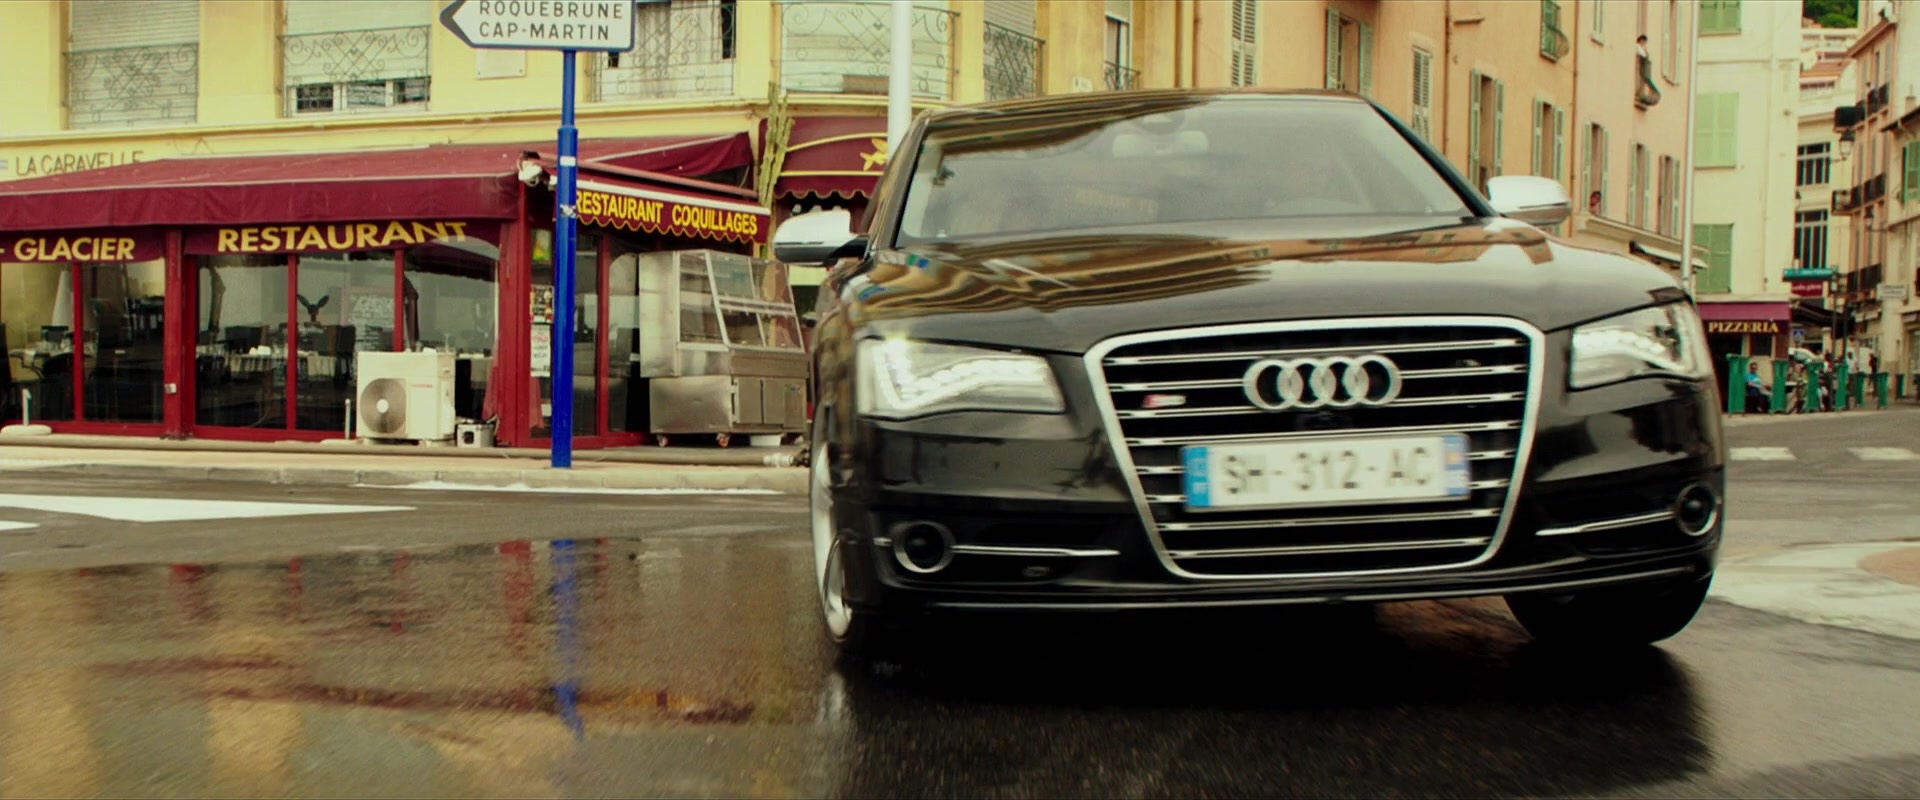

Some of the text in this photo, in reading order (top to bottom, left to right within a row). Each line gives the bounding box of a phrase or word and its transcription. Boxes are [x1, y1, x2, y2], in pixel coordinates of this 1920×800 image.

[479, 1, 623, 19] ROQUEBRUNE
[479, 22, 609, 40] CAP-MARTIN
[16, 156, 37, 177] LA
[672, 204, 758, 236] COQUILLAGES
[217, 220, 467, 252] RESTAURANT
[14, 237, 136, 261] GLACIER
[1708, 321, 1779, 333] PIZZERIA
